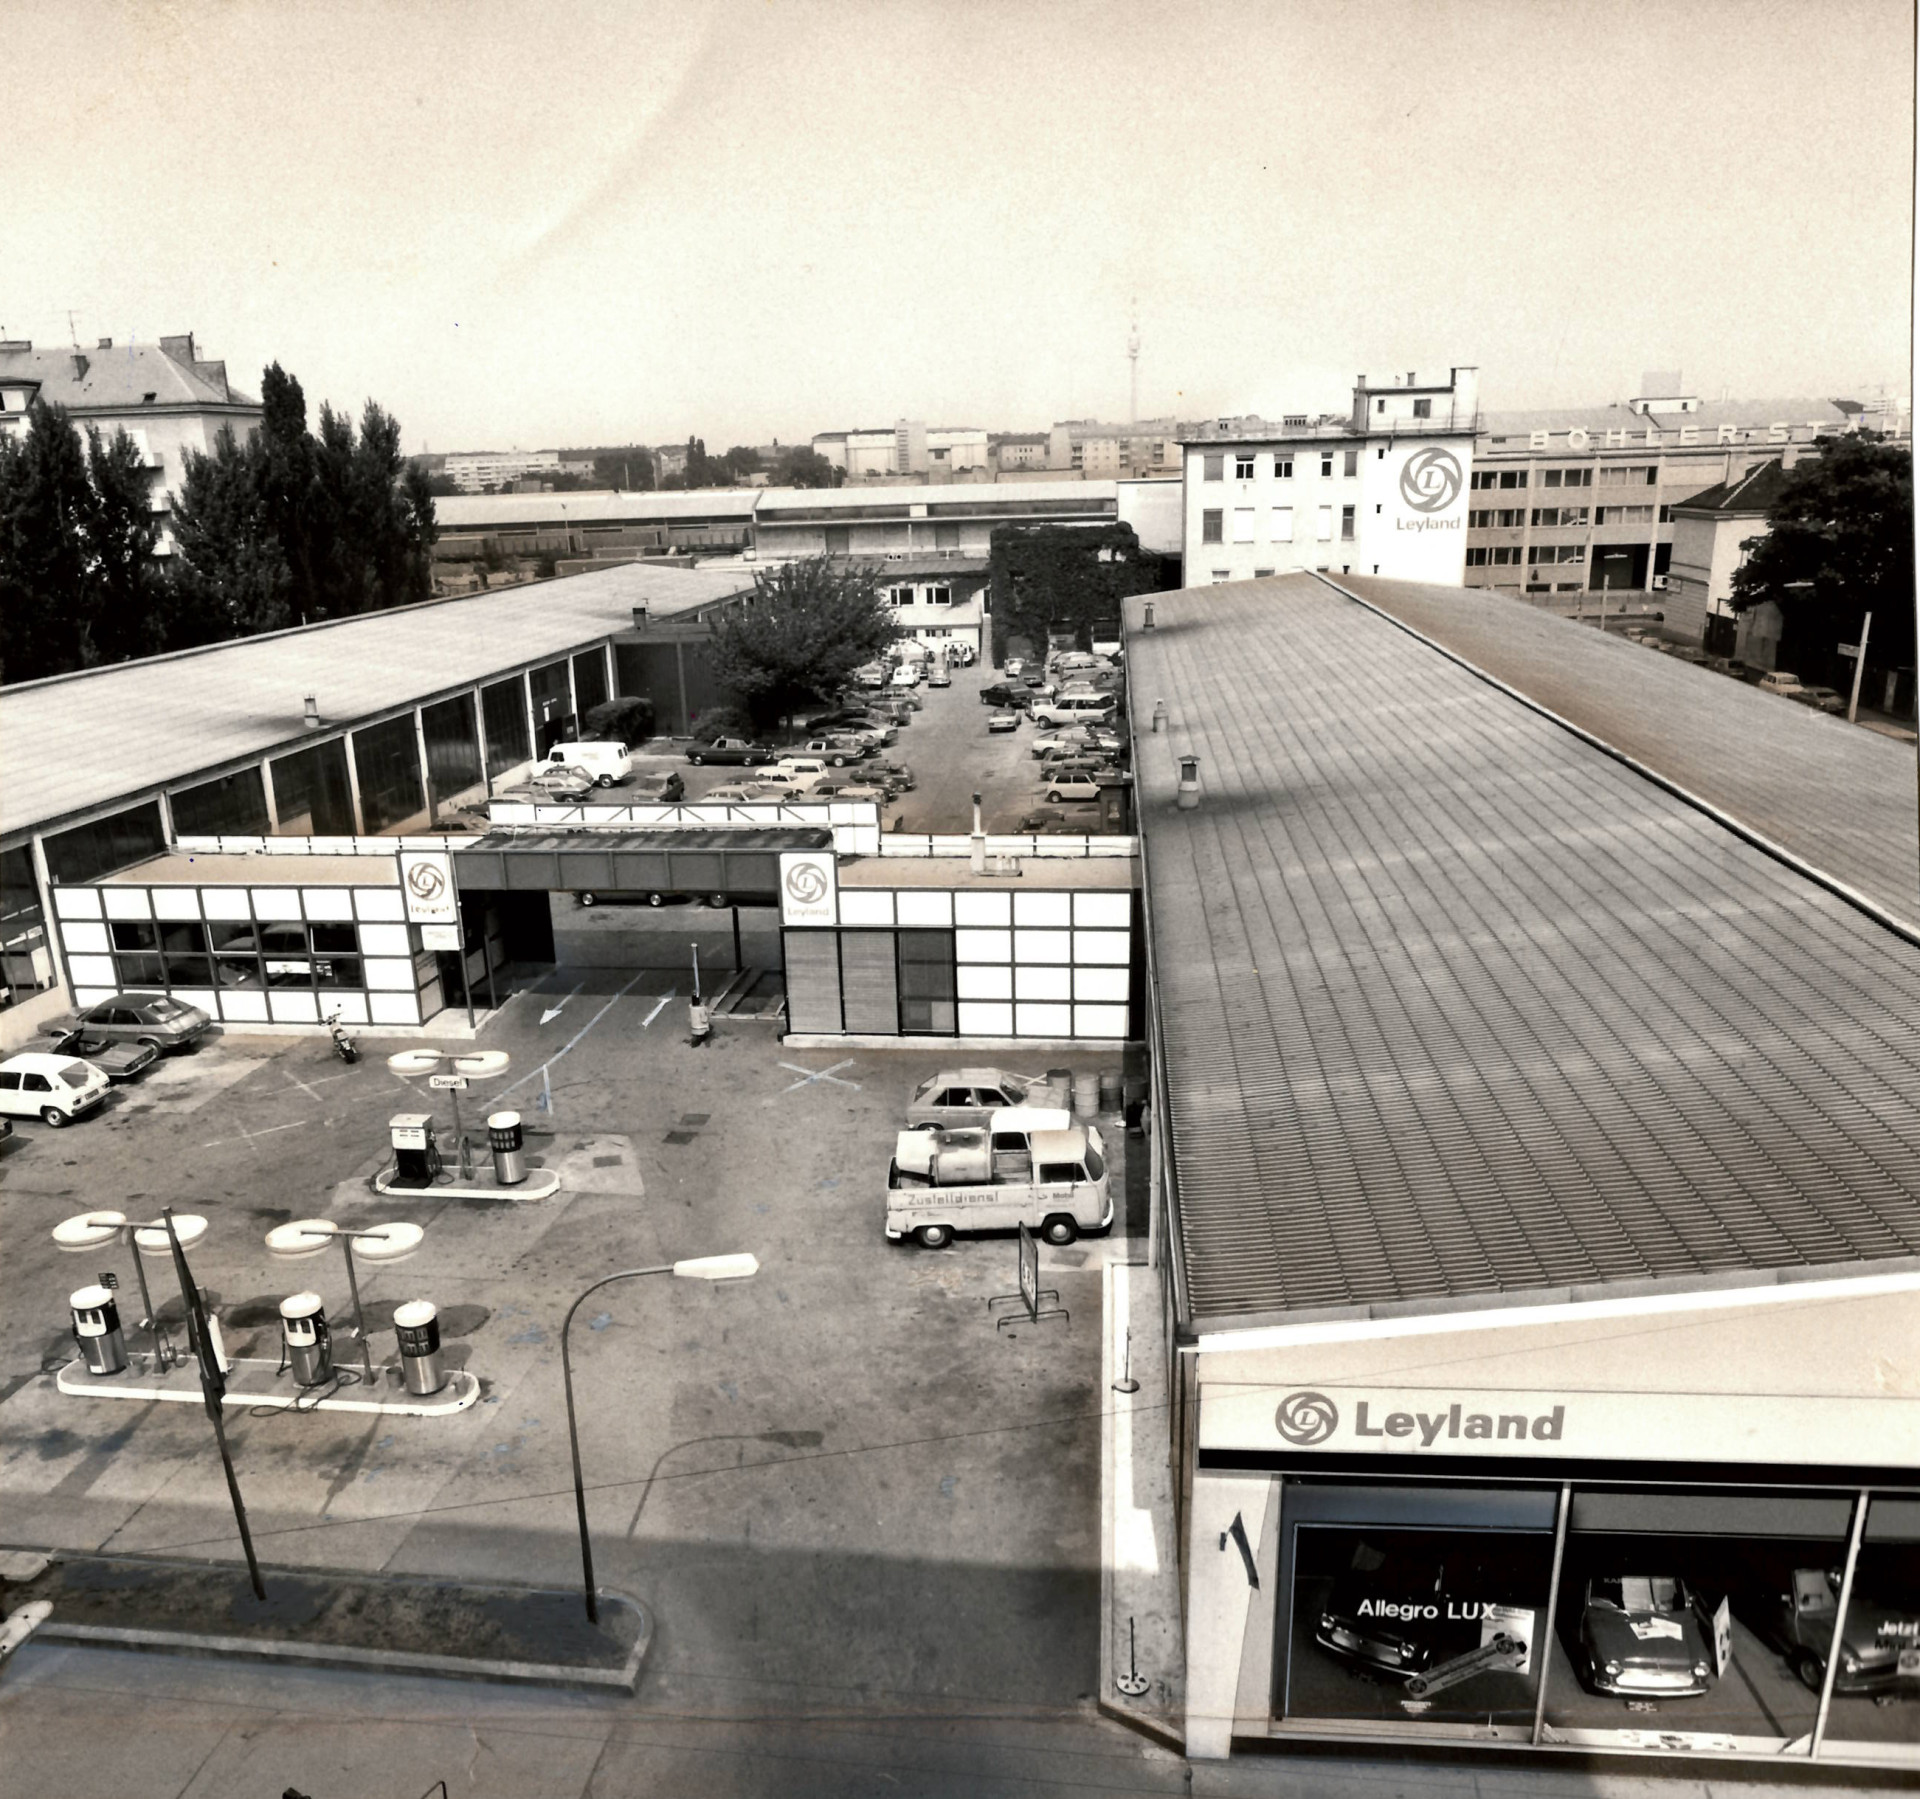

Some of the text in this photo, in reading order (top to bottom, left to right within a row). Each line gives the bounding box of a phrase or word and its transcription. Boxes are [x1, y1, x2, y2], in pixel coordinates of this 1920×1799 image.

[1396, 516, 1462, 533] Leyland
[433, 1077, 463, 1087] Diesel
[1355, 1401, 1566, 1447] Leyland
[1357, 1598, 1439, 1622] Allegro
[1447, 1602, 1497, 1620] LUX
